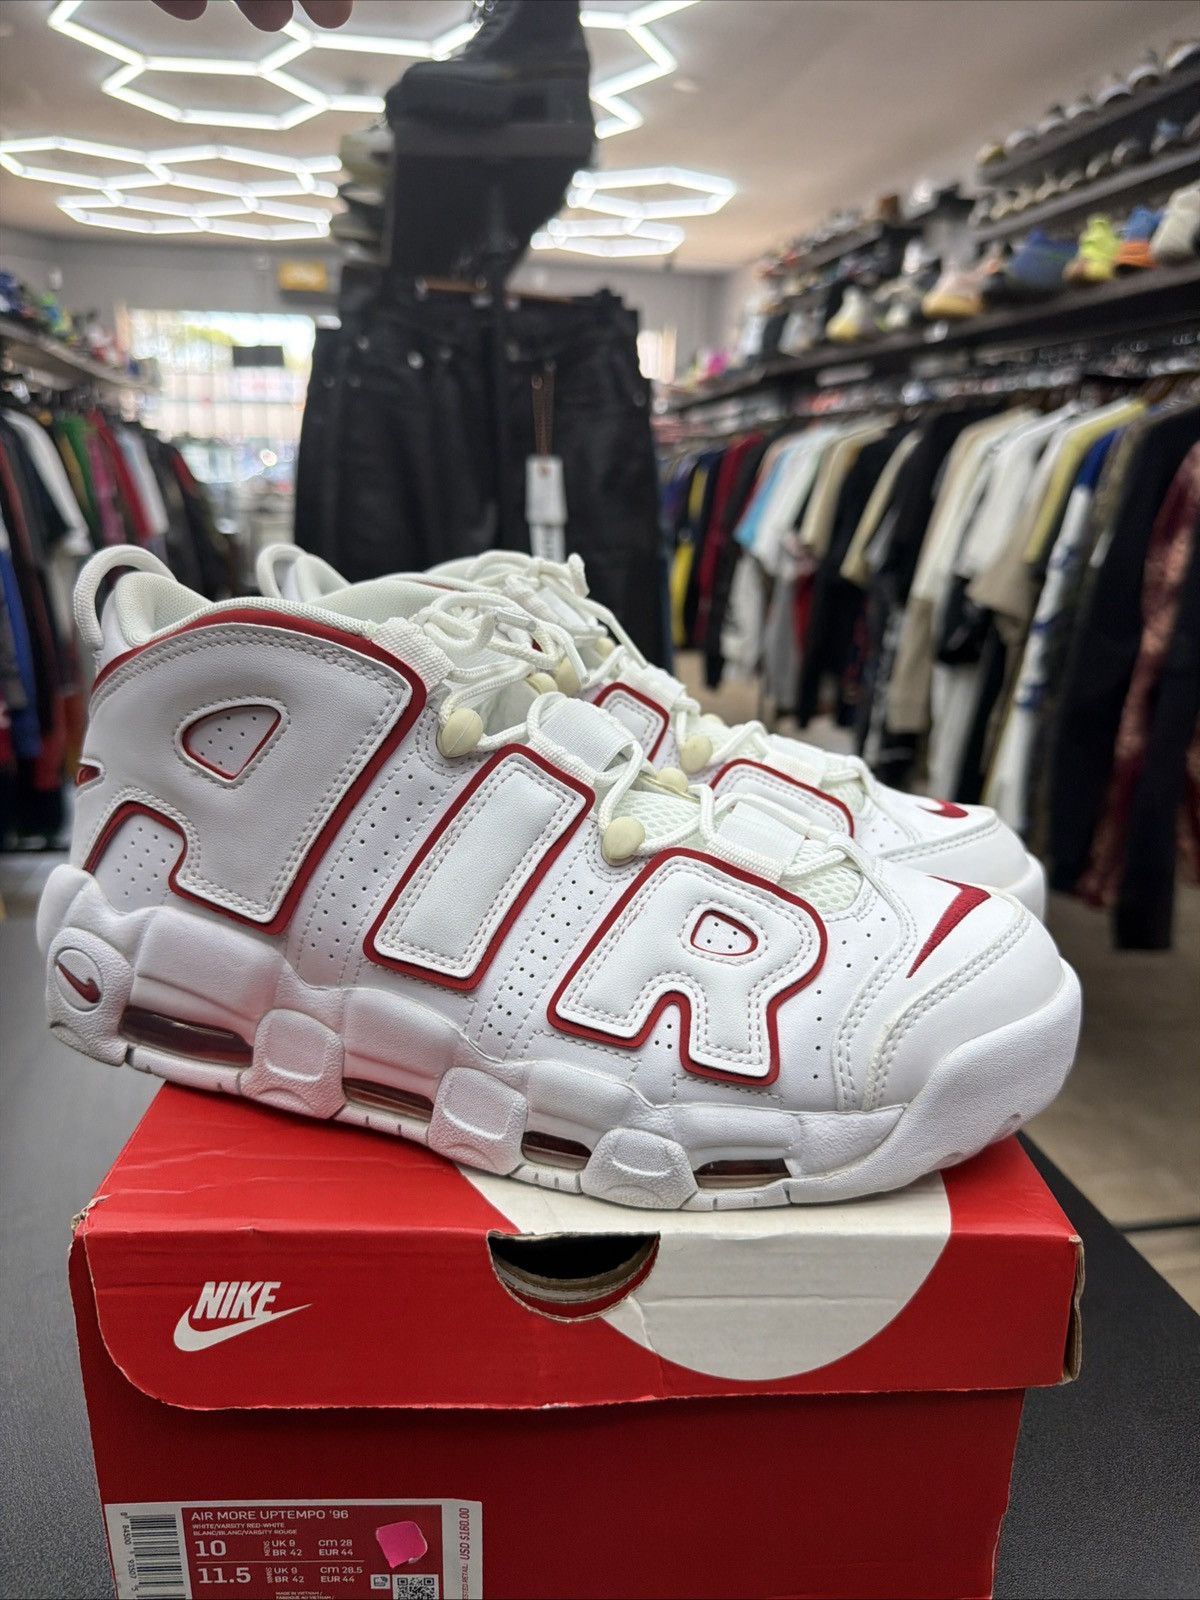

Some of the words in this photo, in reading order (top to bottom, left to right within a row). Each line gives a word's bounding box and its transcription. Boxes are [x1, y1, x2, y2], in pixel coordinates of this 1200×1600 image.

[192, 1281, 282, 1321] NIKE
[191, 1511, 213, 1521] AIR
[217, 1511, 256, 1520] MORE
[260, 1510, 326, 1520] UPTEMPO
[329, 1509, 349, 1519] '96
[458, 1507, 470, 1540] $160.00
[193, 1529, 272, 1537] BLANC/BLANC/VARSITY
[272, 1540, 287, 1548] UK
[195, 1540, 227, 1557] 10
[459, 1542, 471, 1560] USD
[272, 1549, 287, 1557] BR
[290, 1549, 303, 1557] 42
[318, 1549, 339, 1557] EUR
[341, 1566, 363, 1574] 28.5
[198, 1567, 251, 1584] 11.5
[320, 1575, 341, 1583] EUR
[342, 1575, 355, 1583] 44
[274, 1576, 289, 1584] BR
